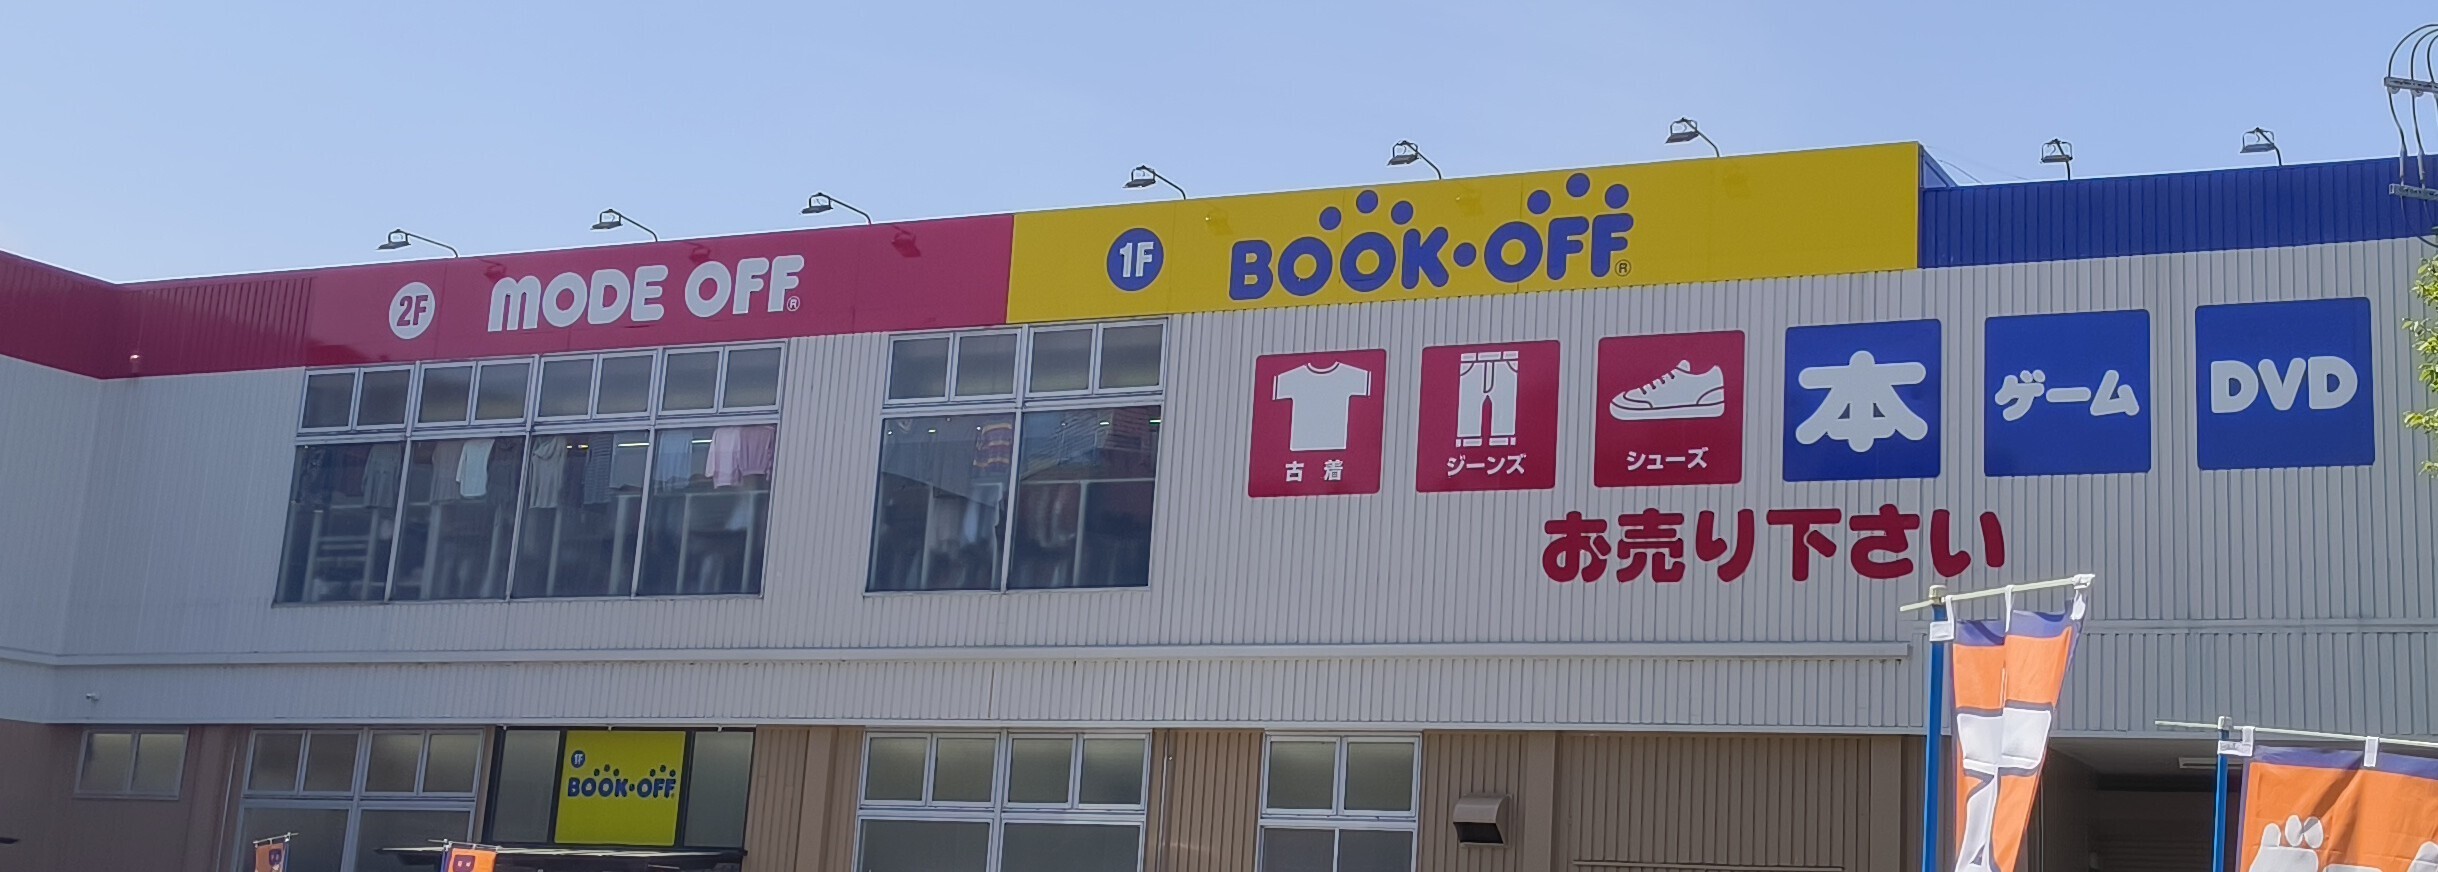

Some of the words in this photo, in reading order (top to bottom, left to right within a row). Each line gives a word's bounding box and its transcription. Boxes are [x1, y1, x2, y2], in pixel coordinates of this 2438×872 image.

[1118, 241, 1155, 278] 1F
[396, 294, 429, 327] 2F
[487, 264, 669, 332] MODE
[1795, 350, 1928, 453] 本
[1995, 369, 2140, 422] ゲーム
[2210, 355, 2358, 414] DVD
[1285, 459, 1344, 483] 古着
[1446, 453, 1526, 478] ジーンズ
[1626, 447, 1709, 472] シューズ
[1542, 504, 2006, 584] お売り下さい
